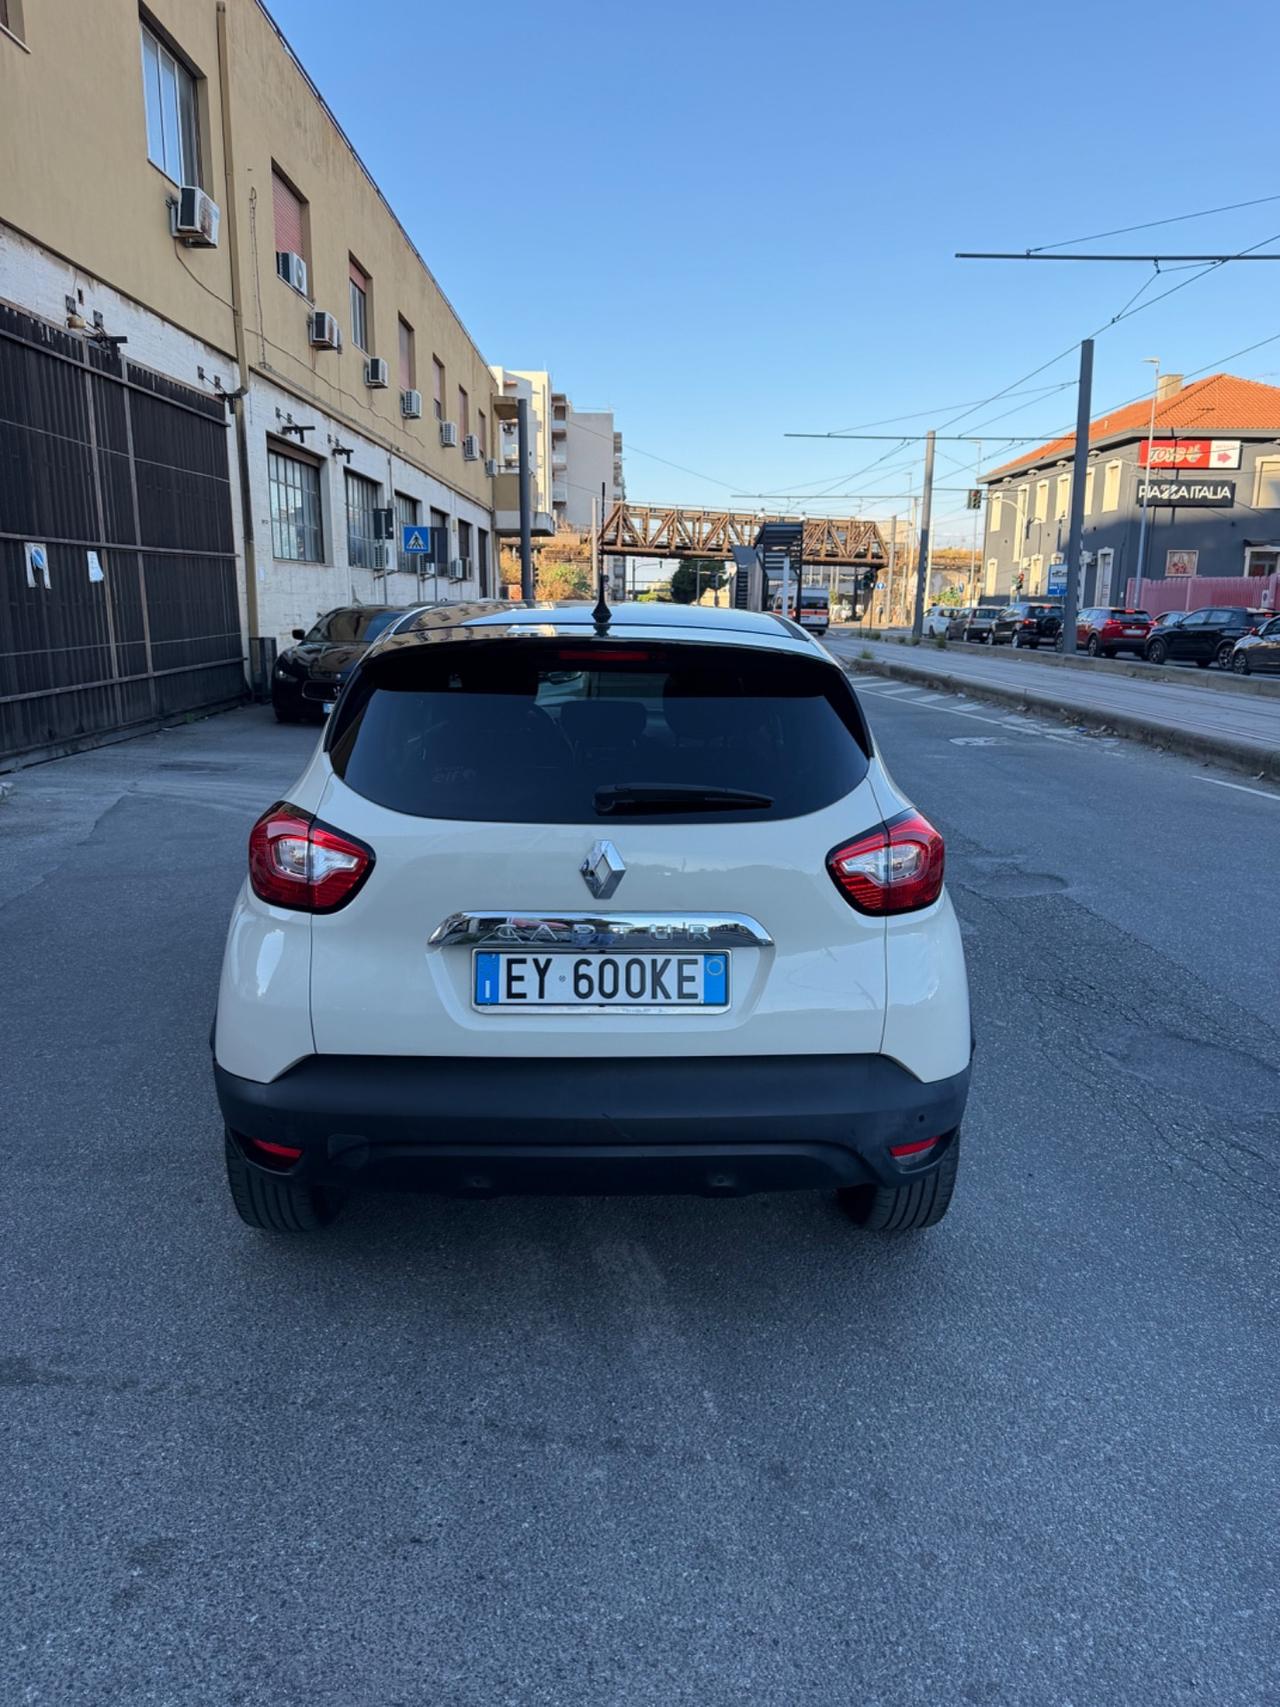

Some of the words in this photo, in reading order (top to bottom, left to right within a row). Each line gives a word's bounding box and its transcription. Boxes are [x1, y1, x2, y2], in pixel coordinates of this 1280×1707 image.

[1138, 485, 1189, 499] PIAZZA
[1190, 485, 1231, 499] ITALIA
[494, 923, 712, 943] CAPTUR
[507, 958, 552, 999] EY
[573, 958, 699, 999] 600KE
